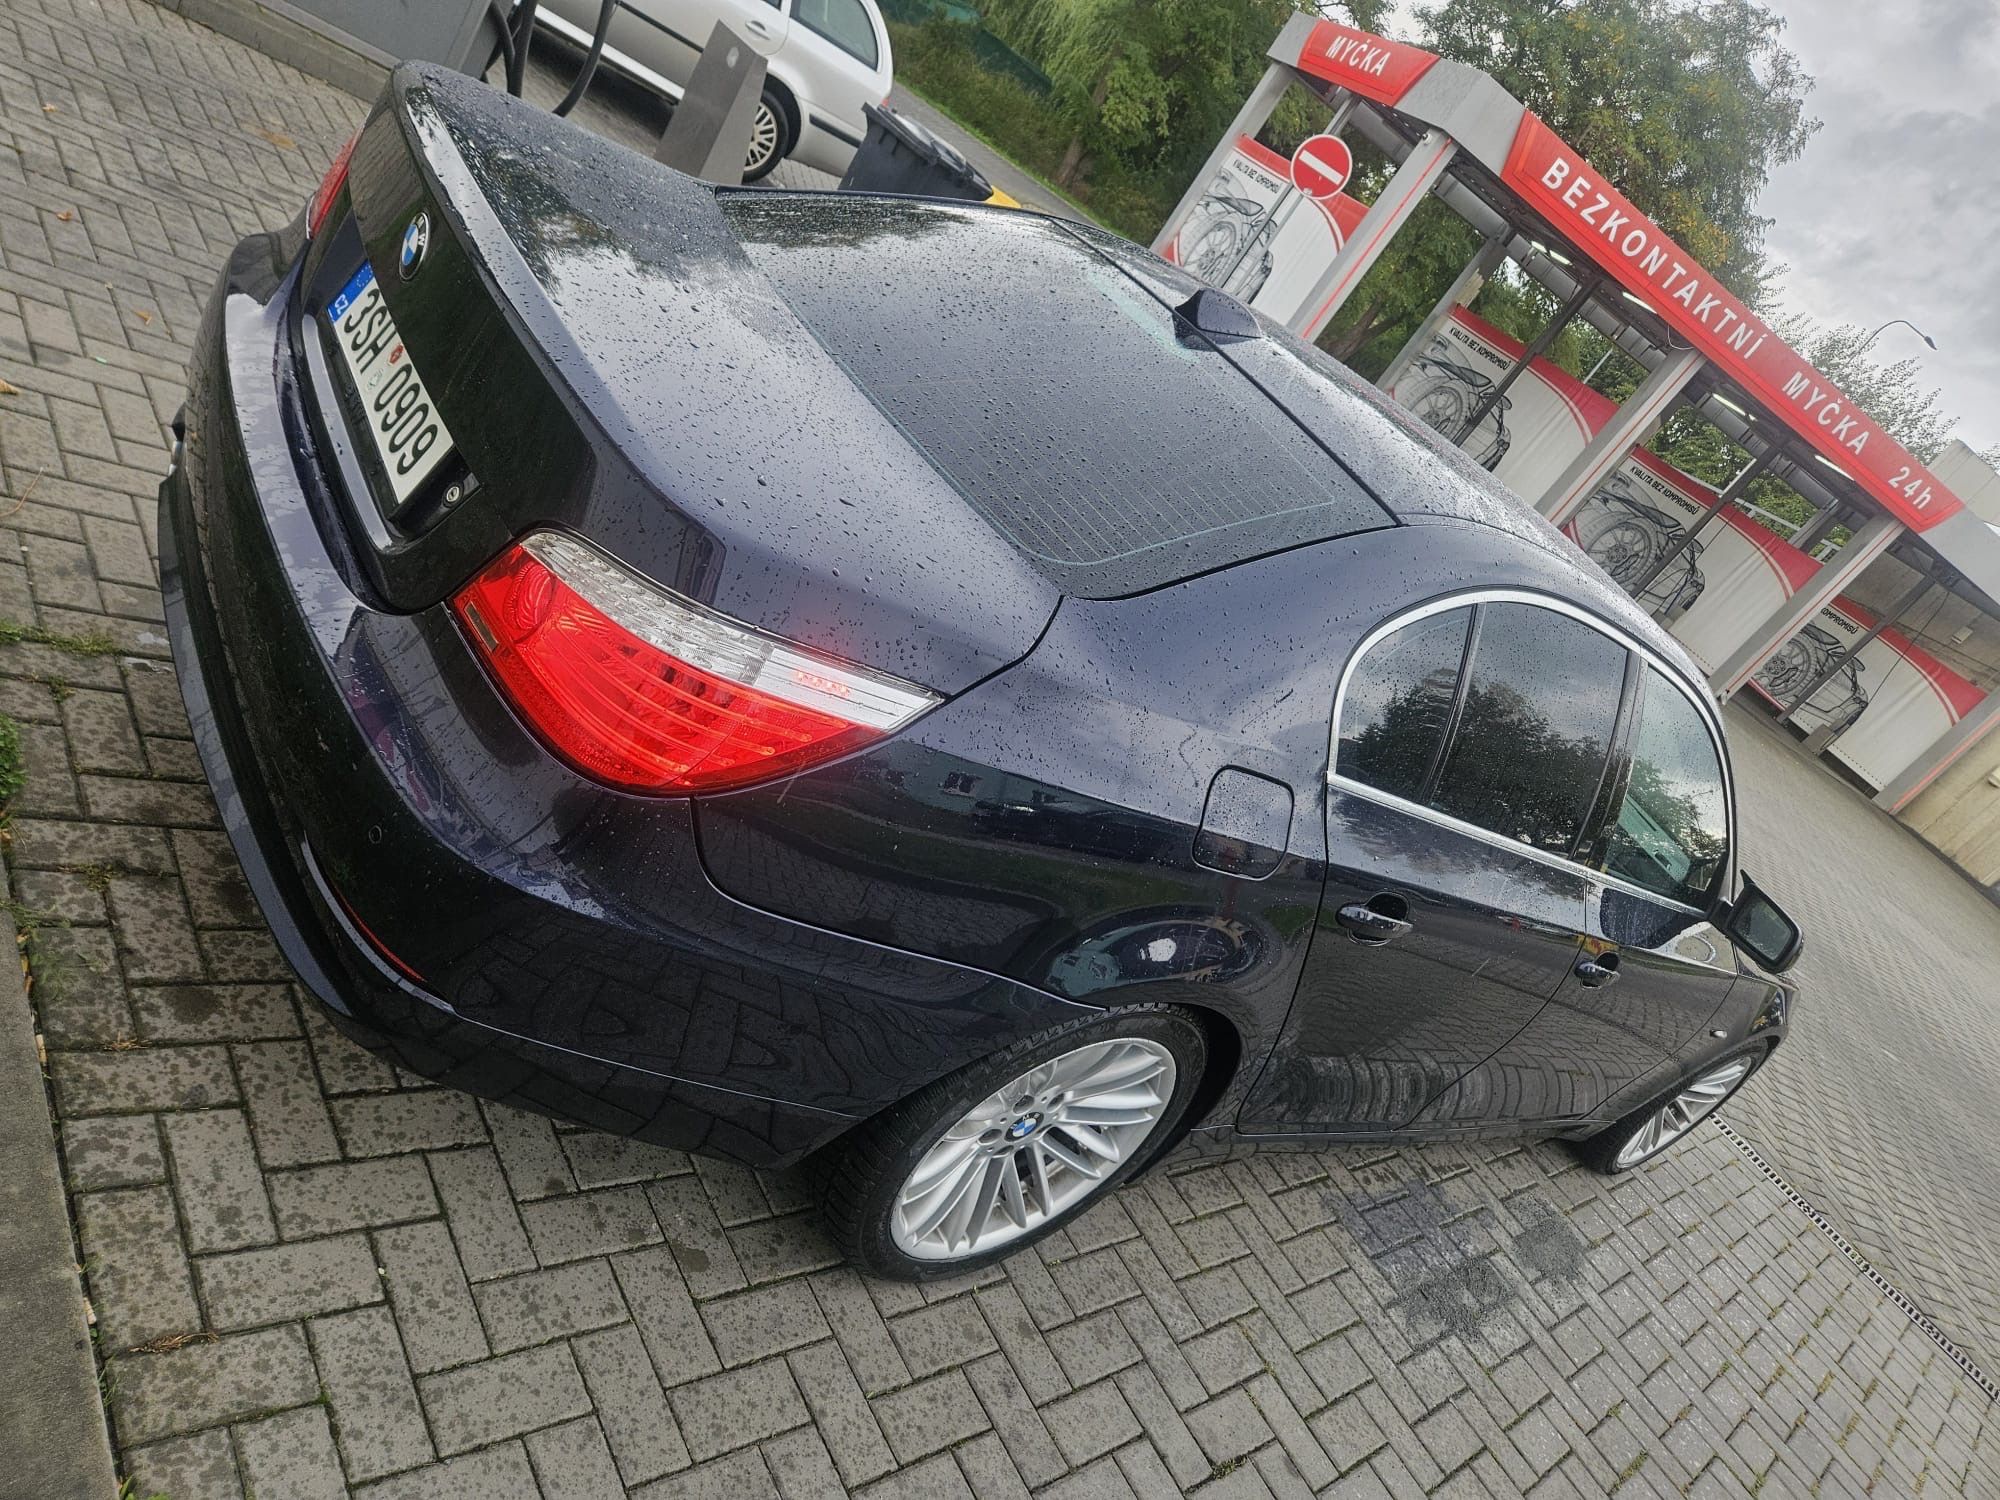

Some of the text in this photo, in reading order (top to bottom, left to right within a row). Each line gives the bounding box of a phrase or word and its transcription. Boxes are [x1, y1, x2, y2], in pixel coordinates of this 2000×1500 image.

[334, 293, 350, 315] CZ
[343, 288, 438, 476] 3SH 0909
[1541, 157, 1932, 510] BEZKONTAKTNÍ MYČKA 24h
